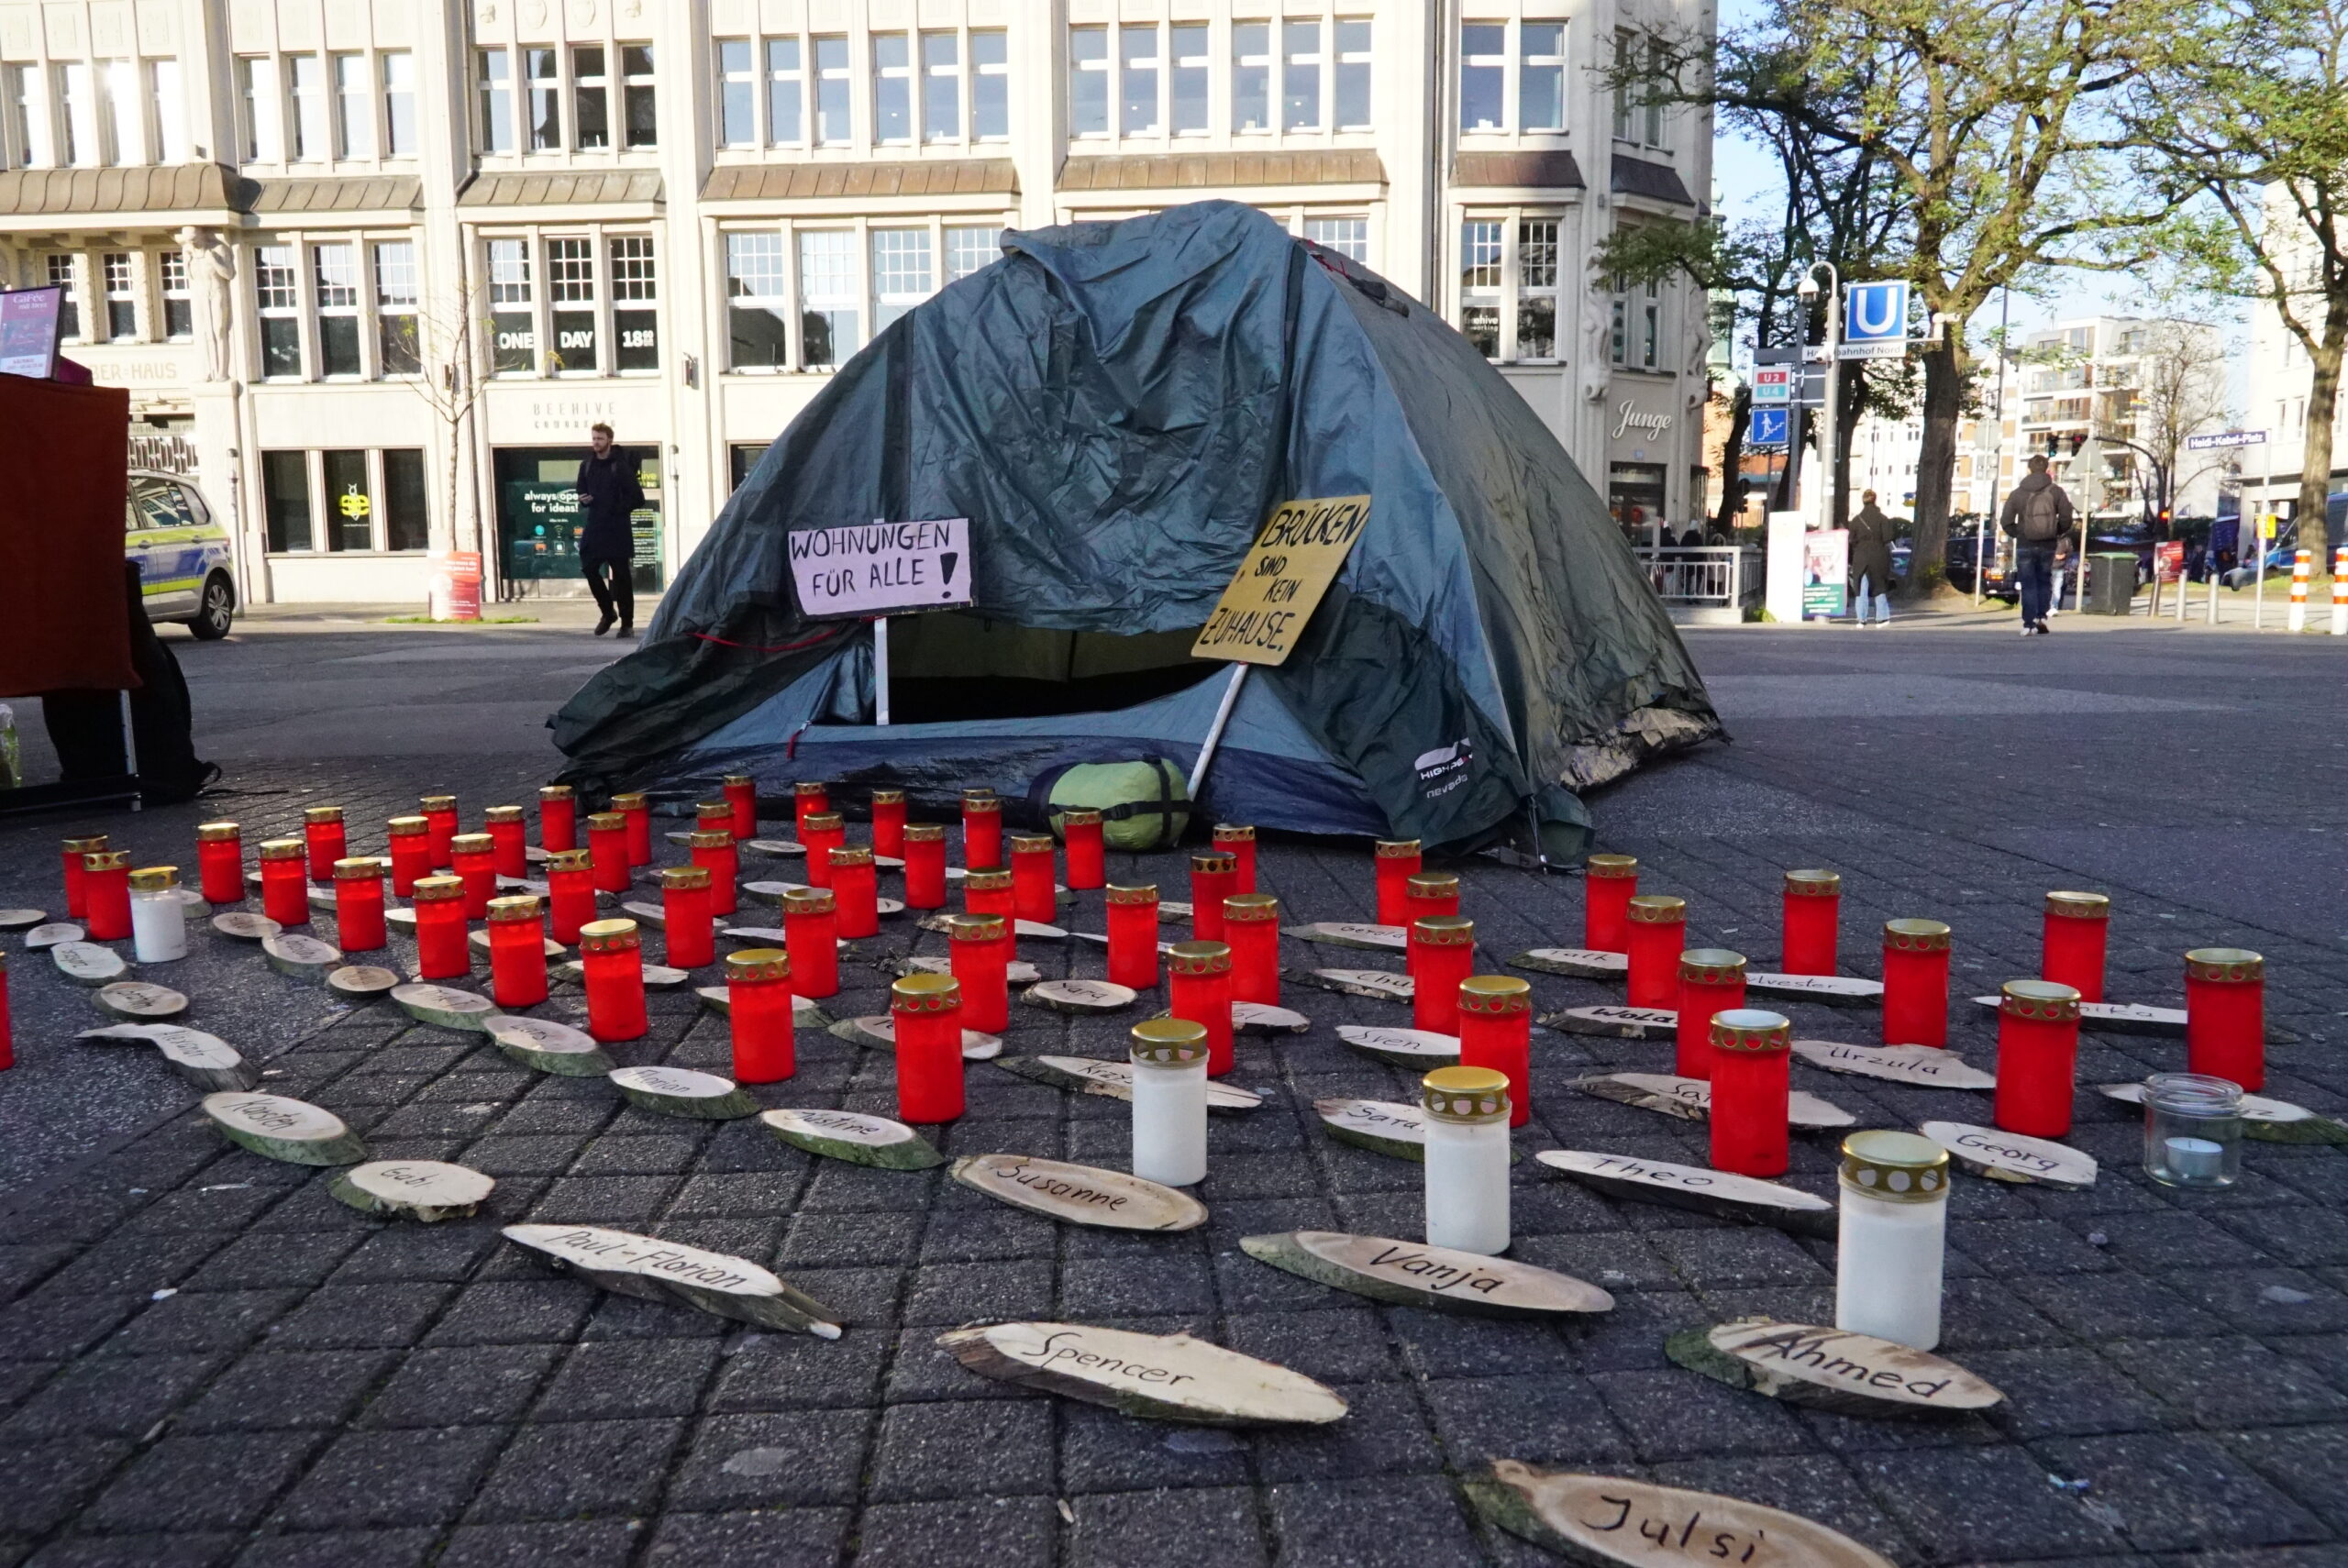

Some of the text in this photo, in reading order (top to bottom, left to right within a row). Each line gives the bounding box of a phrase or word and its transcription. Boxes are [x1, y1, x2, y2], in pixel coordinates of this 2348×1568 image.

[1856, 287, 1898, 335] U
[499, 331, 534, 349] ONE
[559, 330, 593, 348] DAY
[1807, 346, 1900, 357] Hbahnhof Nord
[534, 403, 615, 416] BEEHIVE
[1611, 399, 1673, 441] Junge
[2190, 433, 2264, 448] Heidi-Kabel-Platz
[524, 489, 579, 502] always ope
[531, 501, 579, 513] for ideas!
[1260, 502, 1370, 547] BRÜCKEN
[791, 521, 950, 560] WOHNUNGEN
[1254, 555, 1288, 577] SIND
[813, 568, 857, 597] FÜR
[1262, 579, 1302, 603] KEIN
[1745, 975, 1837, 988] ylvester
[1591, 1008, 1678, 1024] Wola
[1342, 1029, 1421, 1050] Sven
[624, 1069, 690, 1093] Florian
[1077, 1062, 1134, 1085] Krzy
[784, 1110, 880, 1135] Justine
[1956, 1133, 2060, 1172] Georg
[1592, 1157, 1713, 1187] Theo
[996, 1163, 1128, 1212] Susanne
[1368, 1245, 1505, 1295] Vanja
[1020, 1331, 1197, 1386] Spencer
[1766, 1331, 1952, 1399] Ahmed
